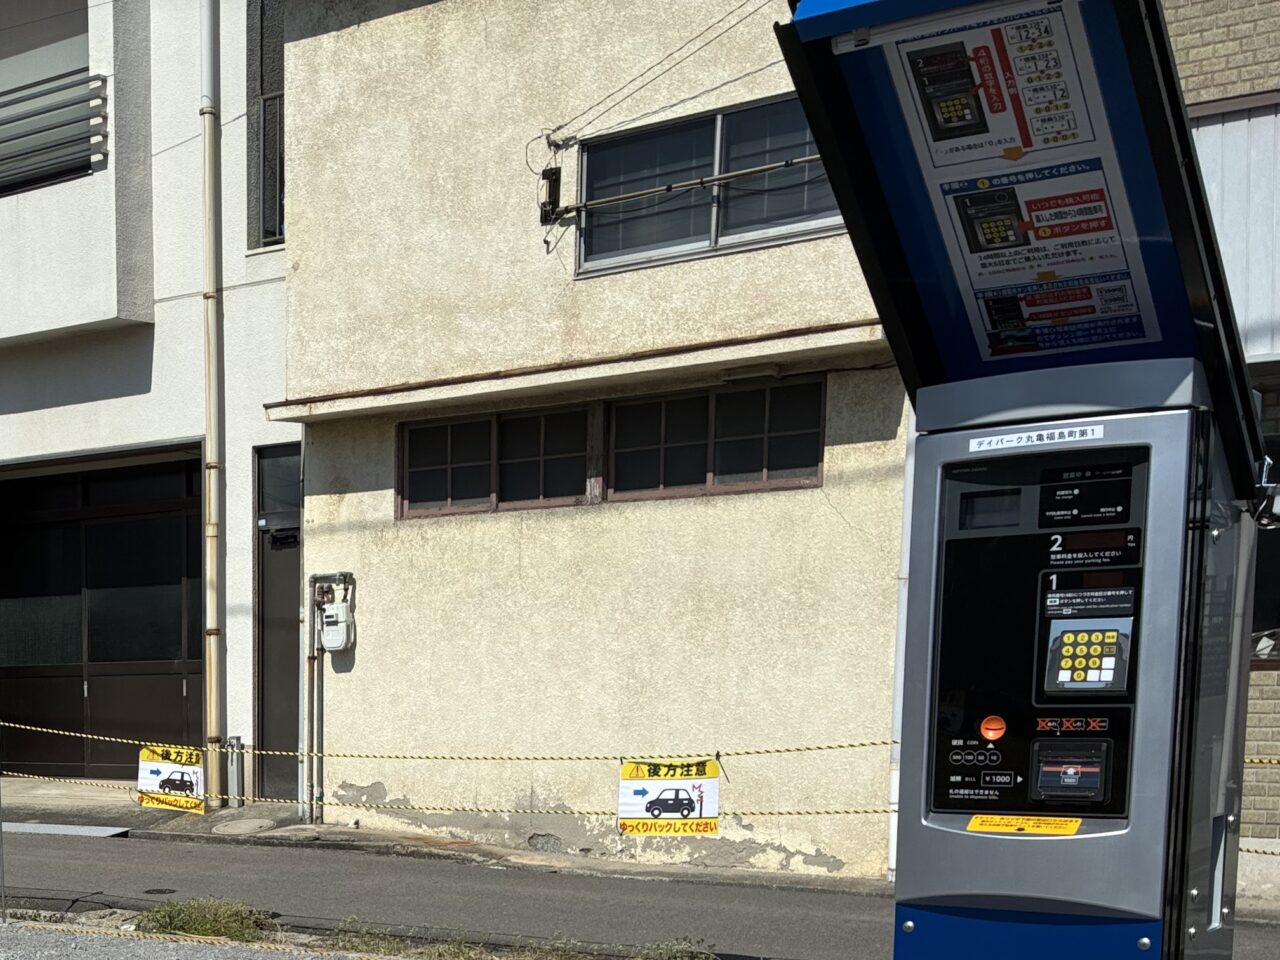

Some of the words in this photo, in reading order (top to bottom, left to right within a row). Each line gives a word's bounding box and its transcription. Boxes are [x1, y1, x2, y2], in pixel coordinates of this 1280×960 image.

[976, 428, 1095, 449] デイパーク丸亀福島町第1
[1049, 534, 1063, 552] 2
[1049, 573, 1058, 591] 1
[647, 761, 707, 778] 後方注意
[620, 821, 718, 833] ゆっくりバックしてください
